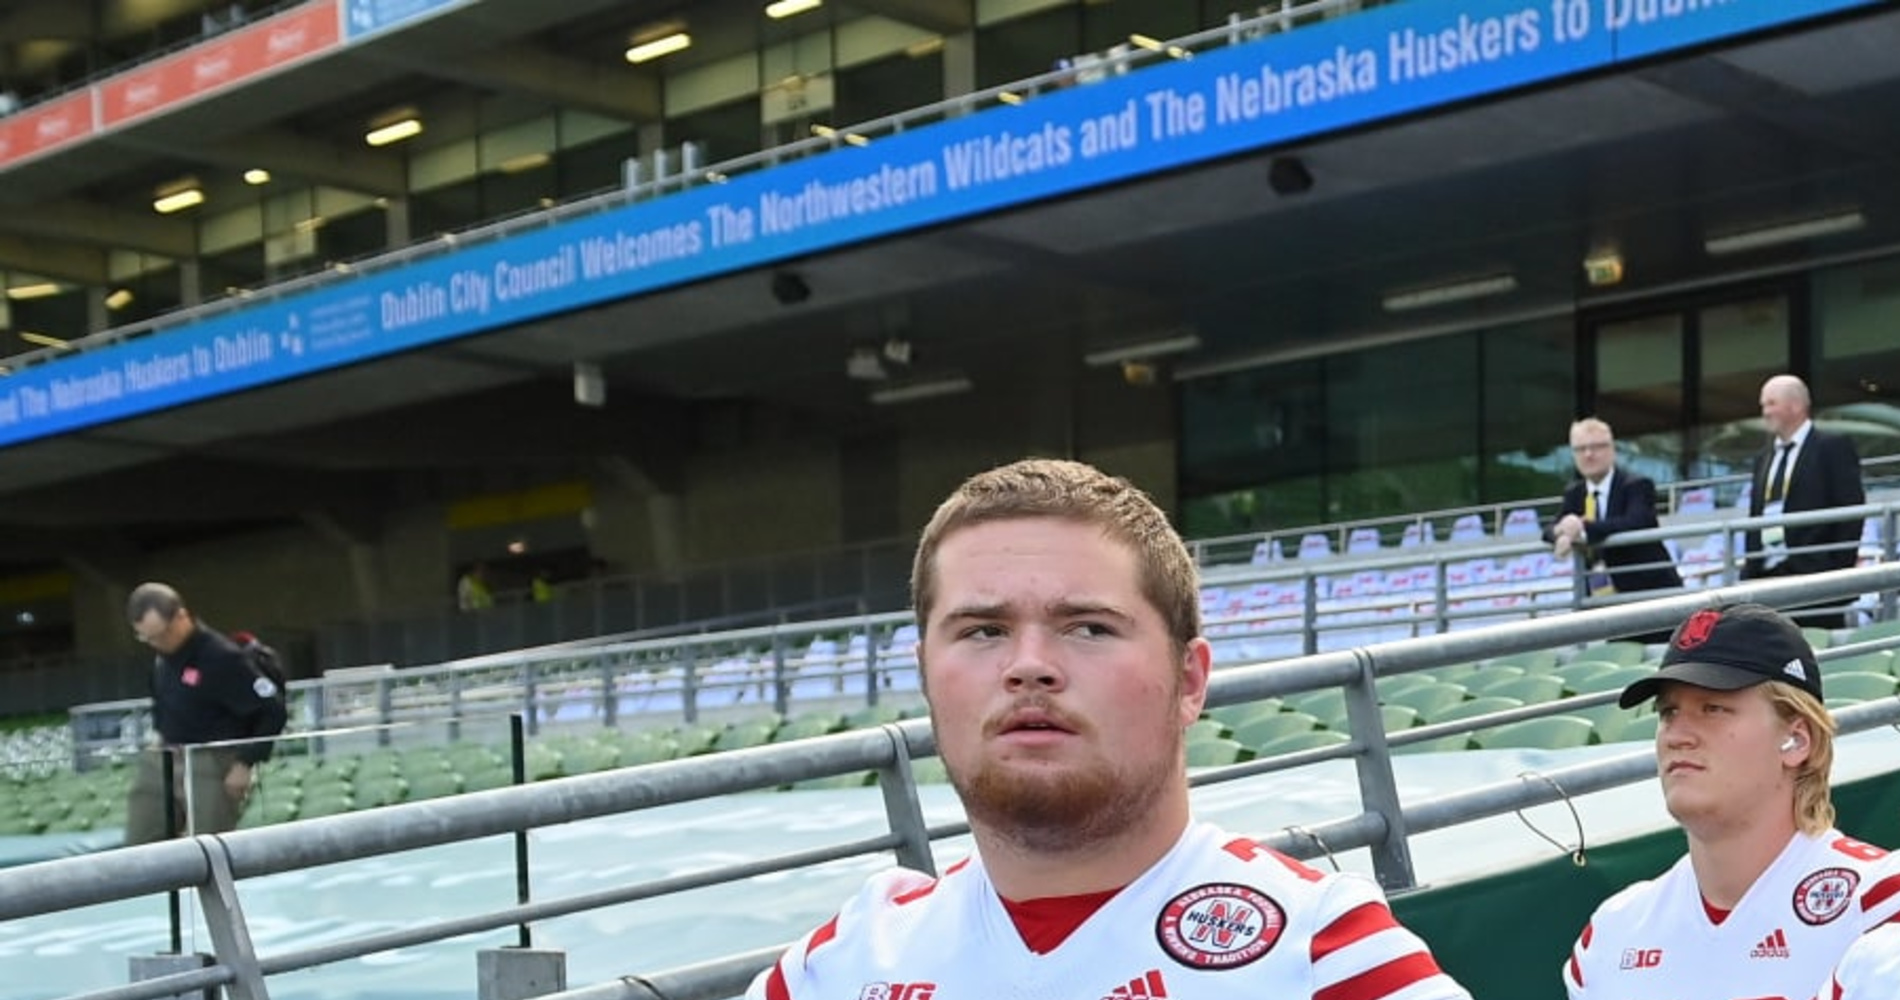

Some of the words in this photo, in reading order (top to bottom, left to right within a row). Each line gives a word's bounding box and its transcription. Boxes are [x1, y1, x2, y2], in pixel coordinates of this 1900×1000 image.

[380, 281, 447, 330] Dublin
[450, 269, 491, 316] City
[494, 245, 577, 300] Council
[580, 219, 700, 281] Welcomes
[708, 202, 754, 248] The
[758, 157, 938, 235] Northwestern
[943, 124, 1072, 192] Wildcats
[1081, 98, 1138, 158] and
[1145, 85, 1207, 140] The
[1216, 45, 1378, 125] Nebraska
[1388, 8, 1540, 84] Huskers
[1552, 0, 1590, 43] to
[124, 353, 191, 393] Huskers
[193, 345, 209, 378] to
[214, 330, 272, 373] Dublin
[1186, 911, 1256, 937] HUSKERS
